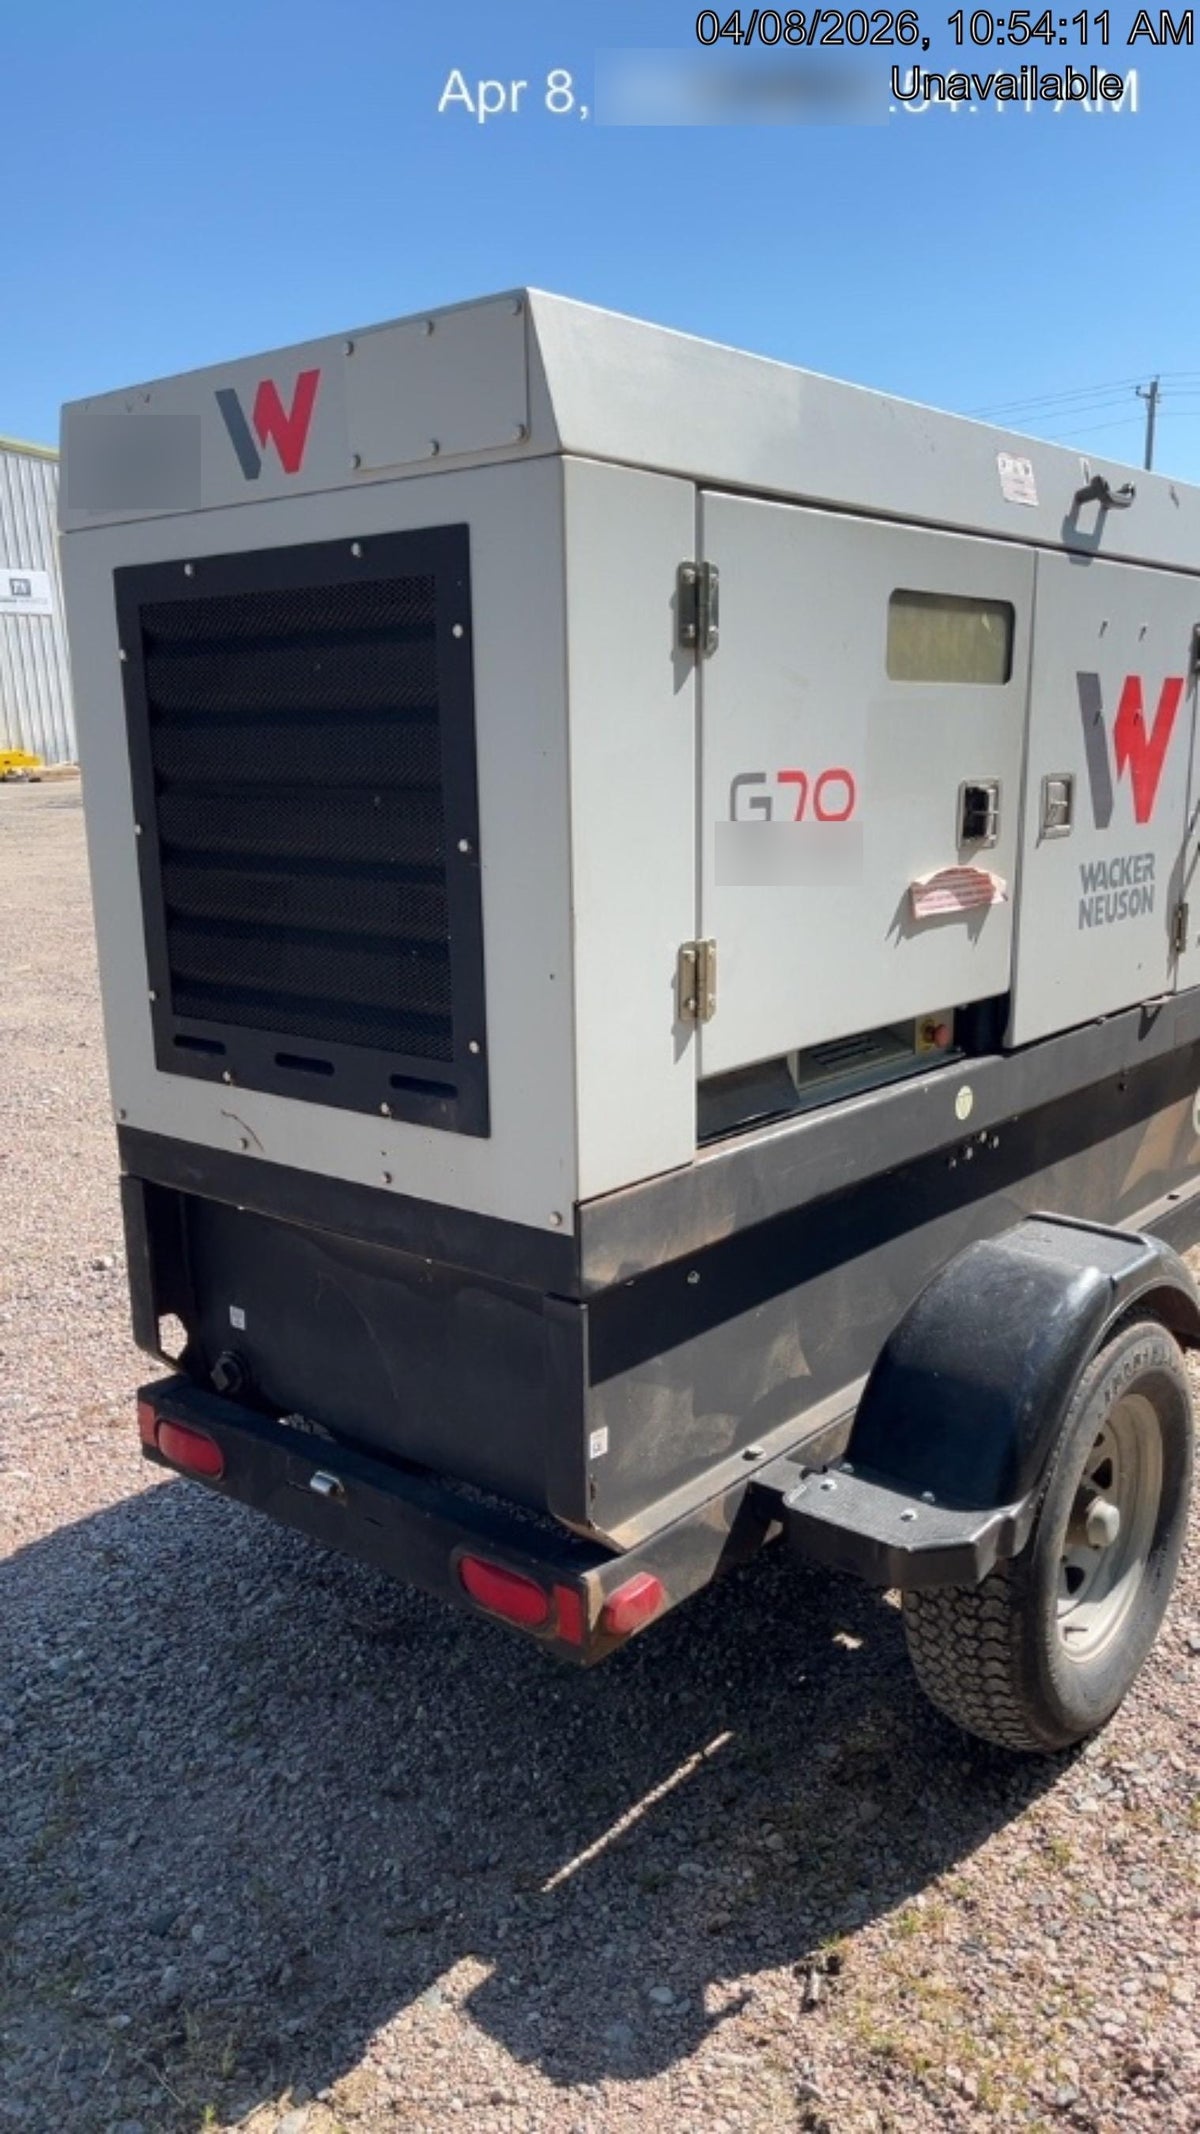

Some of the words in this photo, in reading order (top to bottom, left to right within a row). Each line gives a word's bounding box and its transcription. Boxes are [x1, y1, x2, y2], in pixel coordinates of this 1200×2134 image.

[730, 769, 855, 822] G70
[1079, 853, 1155, 894] WACKER
[1078, 885, 1154, 931] NEUSON
